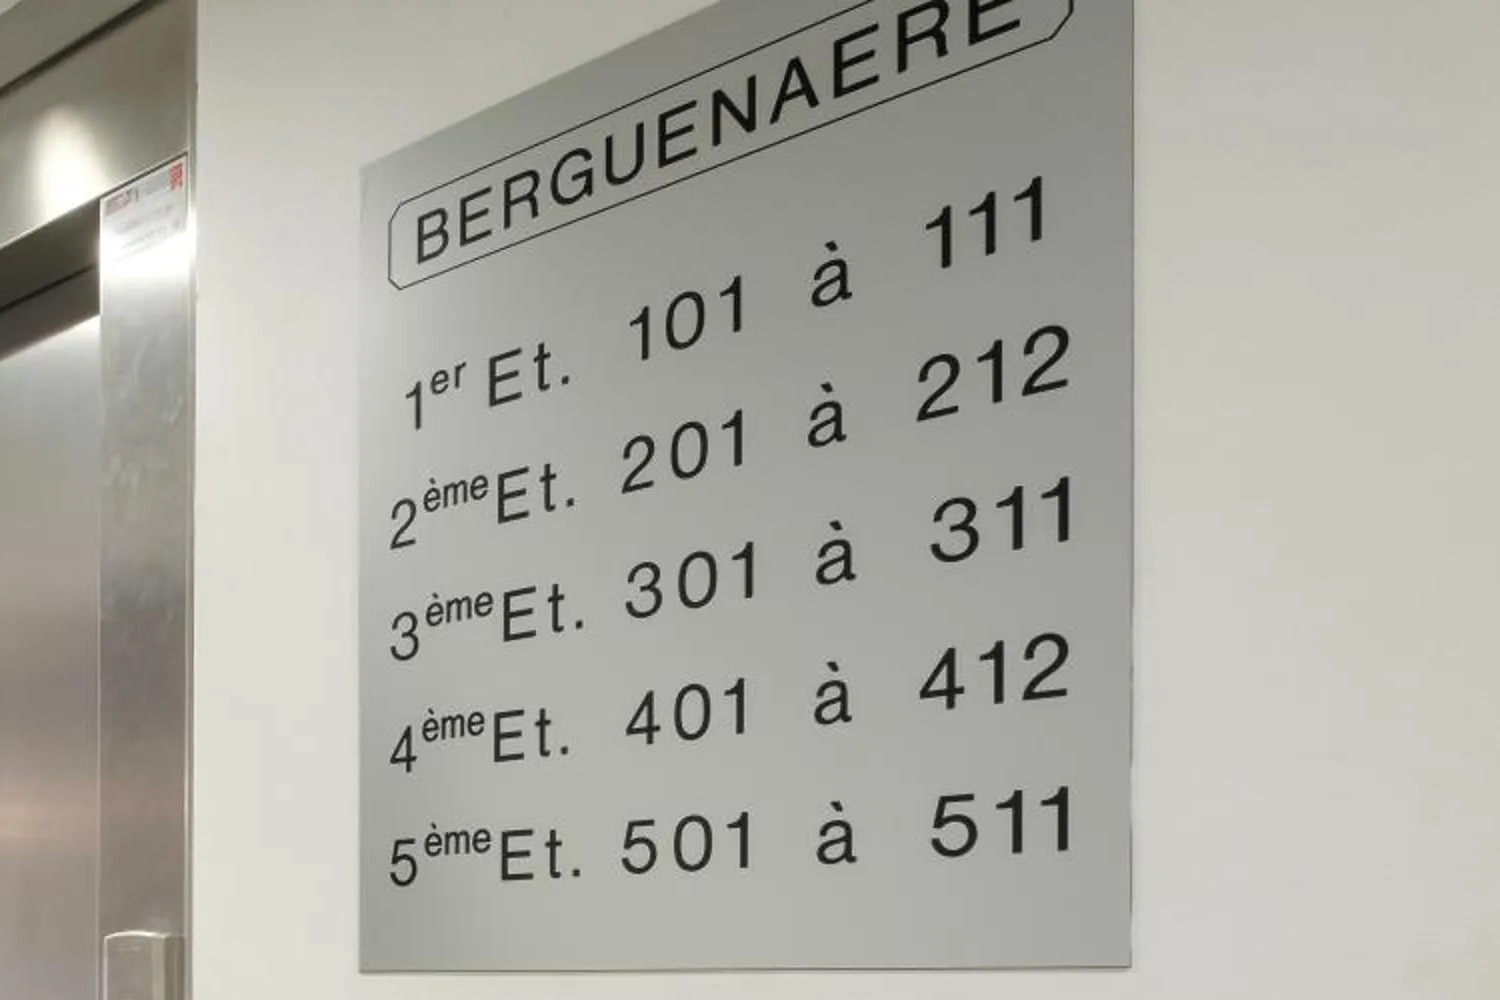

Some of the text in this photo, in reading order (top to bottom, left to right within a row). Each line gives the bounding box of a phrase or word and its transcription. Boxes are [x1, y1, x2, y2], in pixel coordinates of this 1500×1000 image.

[416, 0, 1021, 265] BERGUENAERE
[404, 175, 1043, 431] 1er Et. 101 à 111
[621, 408, 743, 495] 201
[807, 381, 848, 449] à
[915, 324, 1070, 423] 212
[624, 540, 755, 619] 301
[815, 519, 858, 586] à
[929, 475, 1070, 563] 311
[625, 677, 746, 745] 401
[813, 660, 853, 726] à
[918, 632, 1069, 711] 412
[621, 811, 749, 875] 501
[815, 799, 858, 865] à
[930, 785, 1069, 859] 511
